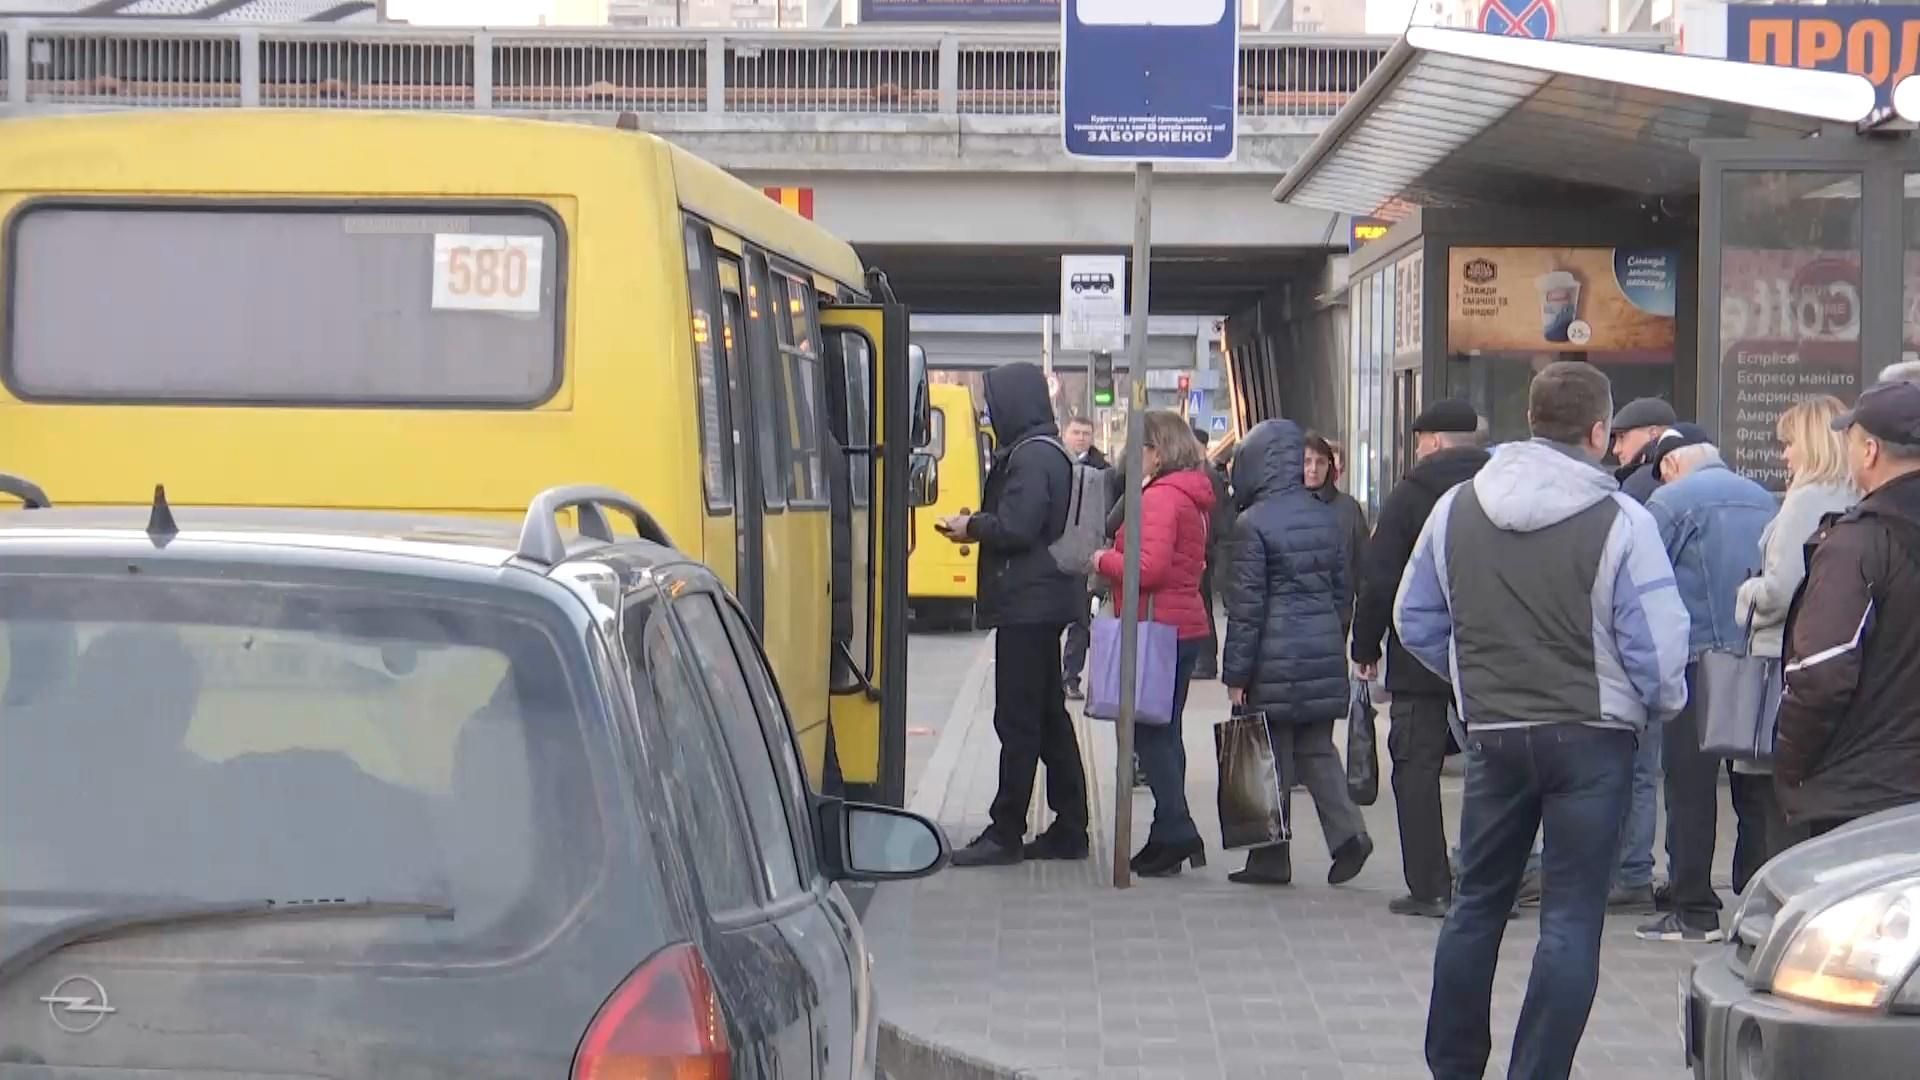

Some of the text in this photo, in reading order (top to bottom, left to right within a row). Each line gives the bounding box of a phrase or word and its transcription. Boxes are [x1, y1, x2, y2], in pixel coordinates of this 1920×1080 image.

[1087, 130, 1212, 143] ЗАБОРОНЕНО!
[448, 245, 528, 298] 580
[1737, 352, 1797, 367] Еспресо
[1737, 371, 1796, 387] Еспресо
[1736, 427, 1774, 441] Флет
